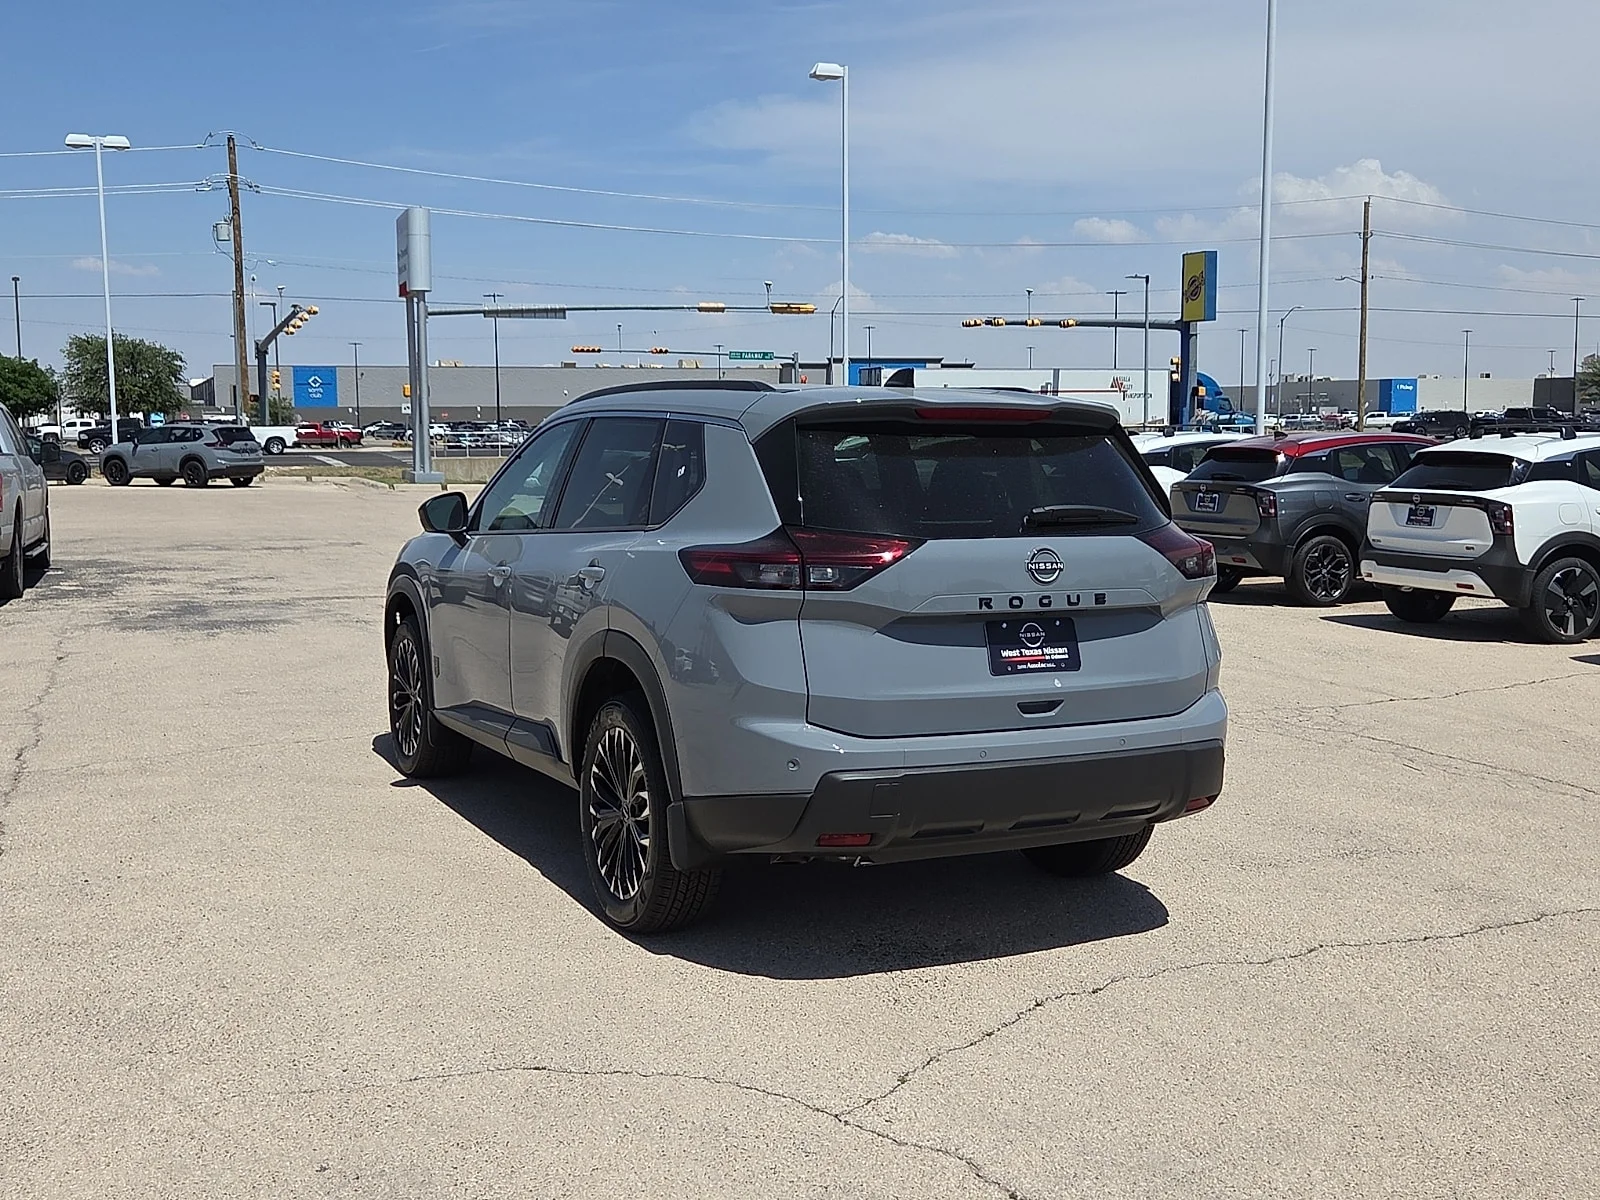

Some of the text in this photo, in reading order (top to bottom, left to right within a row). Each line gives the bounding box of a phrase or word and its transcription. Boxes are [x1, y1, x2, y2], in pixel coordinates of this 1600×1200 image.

[1028, 562, 1064, 570] NISSAN
[978, 593, 1107, 609] ROGUE
[1001, 646, 1068, 658] West Texas Nissan
